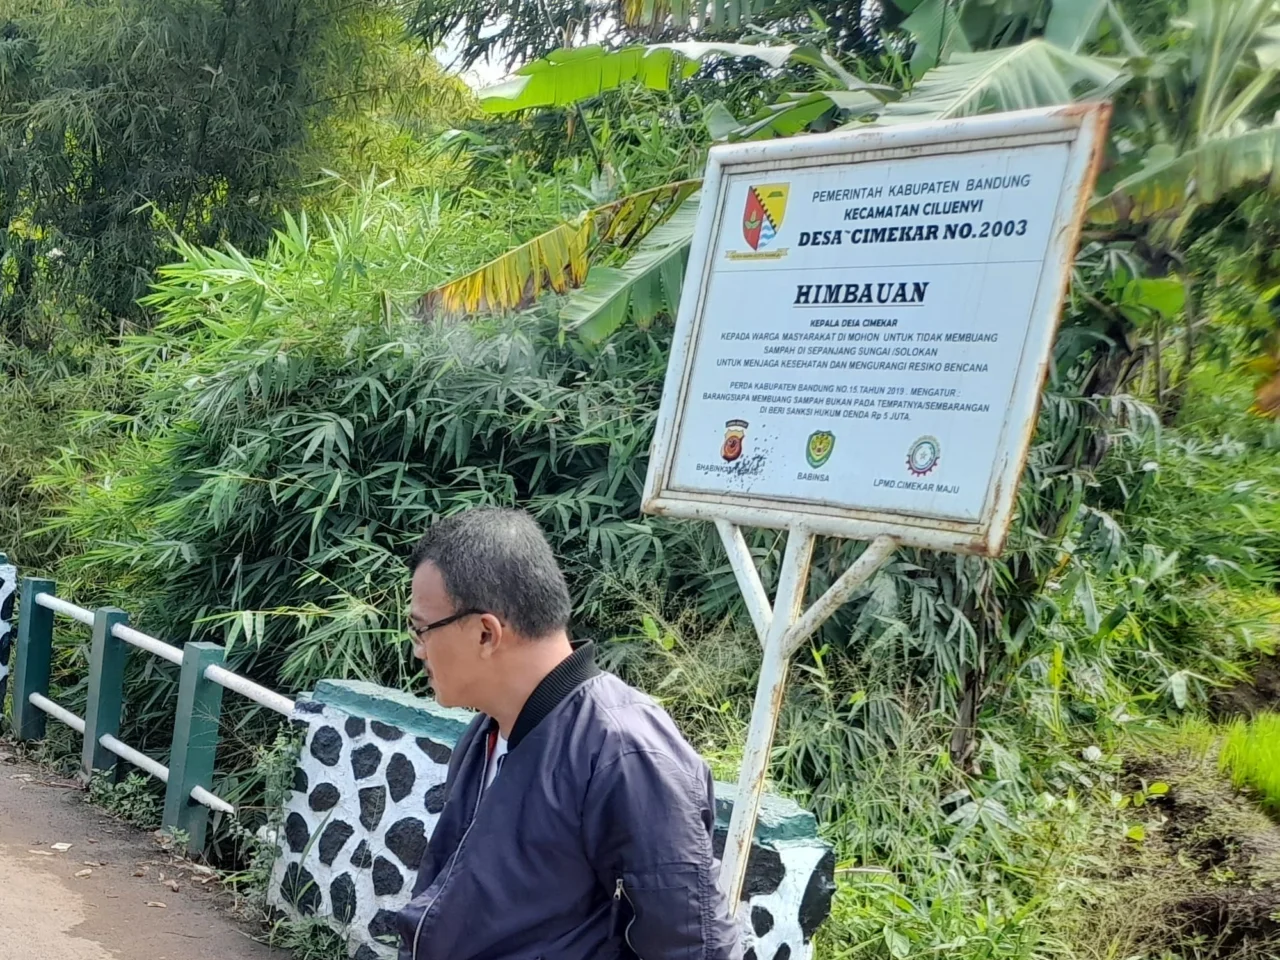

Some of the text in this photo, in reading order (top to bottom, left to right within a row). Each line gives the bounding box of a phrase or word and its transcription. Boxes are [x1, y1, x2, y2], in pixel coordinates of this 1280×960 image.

[812, 174, 1031, 203] PEMERINTAH KABUPATEN BANDUNG
[843, 204, 920, 221] KECAMATAN
[798, 219, 1028, 247] DESA CIMEKAR NO.2003
[793, 282, 930, 304] HIMBAUAN
[810, 318, 898, 328] KEPALA DESA CIMEKAR
[720, 332, 998, 343] KEPADA WARGA MASYARAKAT DI MOHON UNTUK TIDAK MEMBUANG
[764, 345, 795, 355] SAMPAH
[797, 346, 807, 355] DI
[807, 346, 857, 356] SEPANJANG
[858, 347, 891, 356] SUNGAI
[716, 359, 988, 372] UNTUK MENJAGA KESEHATAN DAN MENGURANGI RESIKO BENCANA
[730, 381, 752, 390] PERDA
[754, 382, 796, 391] KABUPATEN
[798, 384, 834, 393] BANDUNG
[703, 392, 750, 402] BARANGSIAPA
[752, 394, 792, 404] MEMBUANG
[793, 396, 824, 406] SAMPAH
[825, 397, 852, 407] BUKAN
[853, 398, 875, 407] PADA
[760, 406, 767, 414] DI
[768, 406, 785, 415] BERI
[786, 407, 813, 416] SANKSI
[814, 408, 841, 417] HUKUM
[842, 410, 869, 419] DENDA
[871, 411, 881, 421] Rp
[883, 412, 888, 420] 5
[797, 472, 829, 482] BABINSA
[935, 484, 960, 494] MAJU
